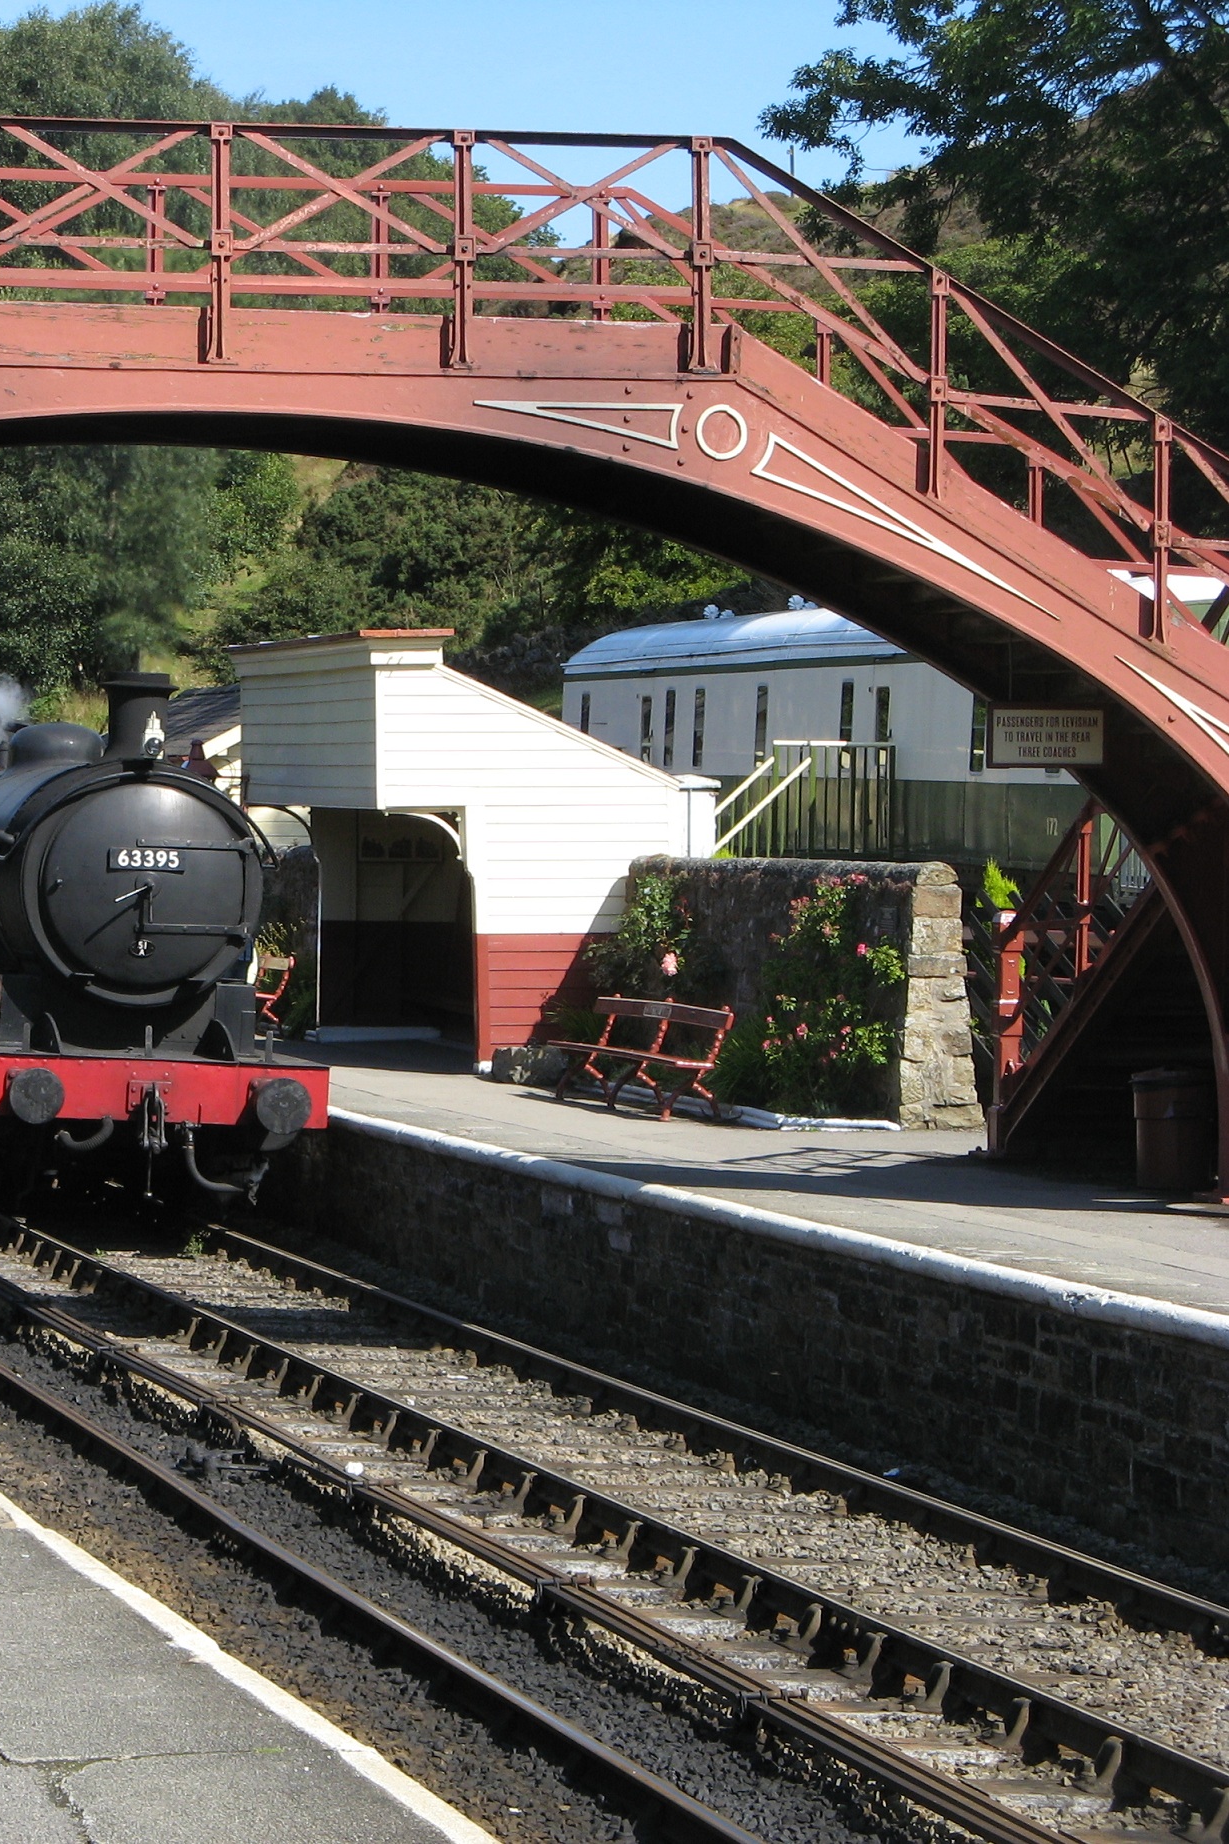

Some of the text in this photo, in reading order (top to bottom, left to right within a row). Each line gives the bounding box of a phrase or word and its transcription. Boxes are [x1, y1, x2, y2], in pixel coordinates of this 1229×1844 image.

[996, 716, 1099, 728] PASSENGERS FOR LEVISHAM
[1004, 732, 1091, 742] TO TRAVEL IN THE REAR
[1018, 747, 1077, 758] THREE COACHES
[1046, 816, 1058, 836] 172
[117, 849, 180, 869] 63395
[137, 940, 148, 950] 51
